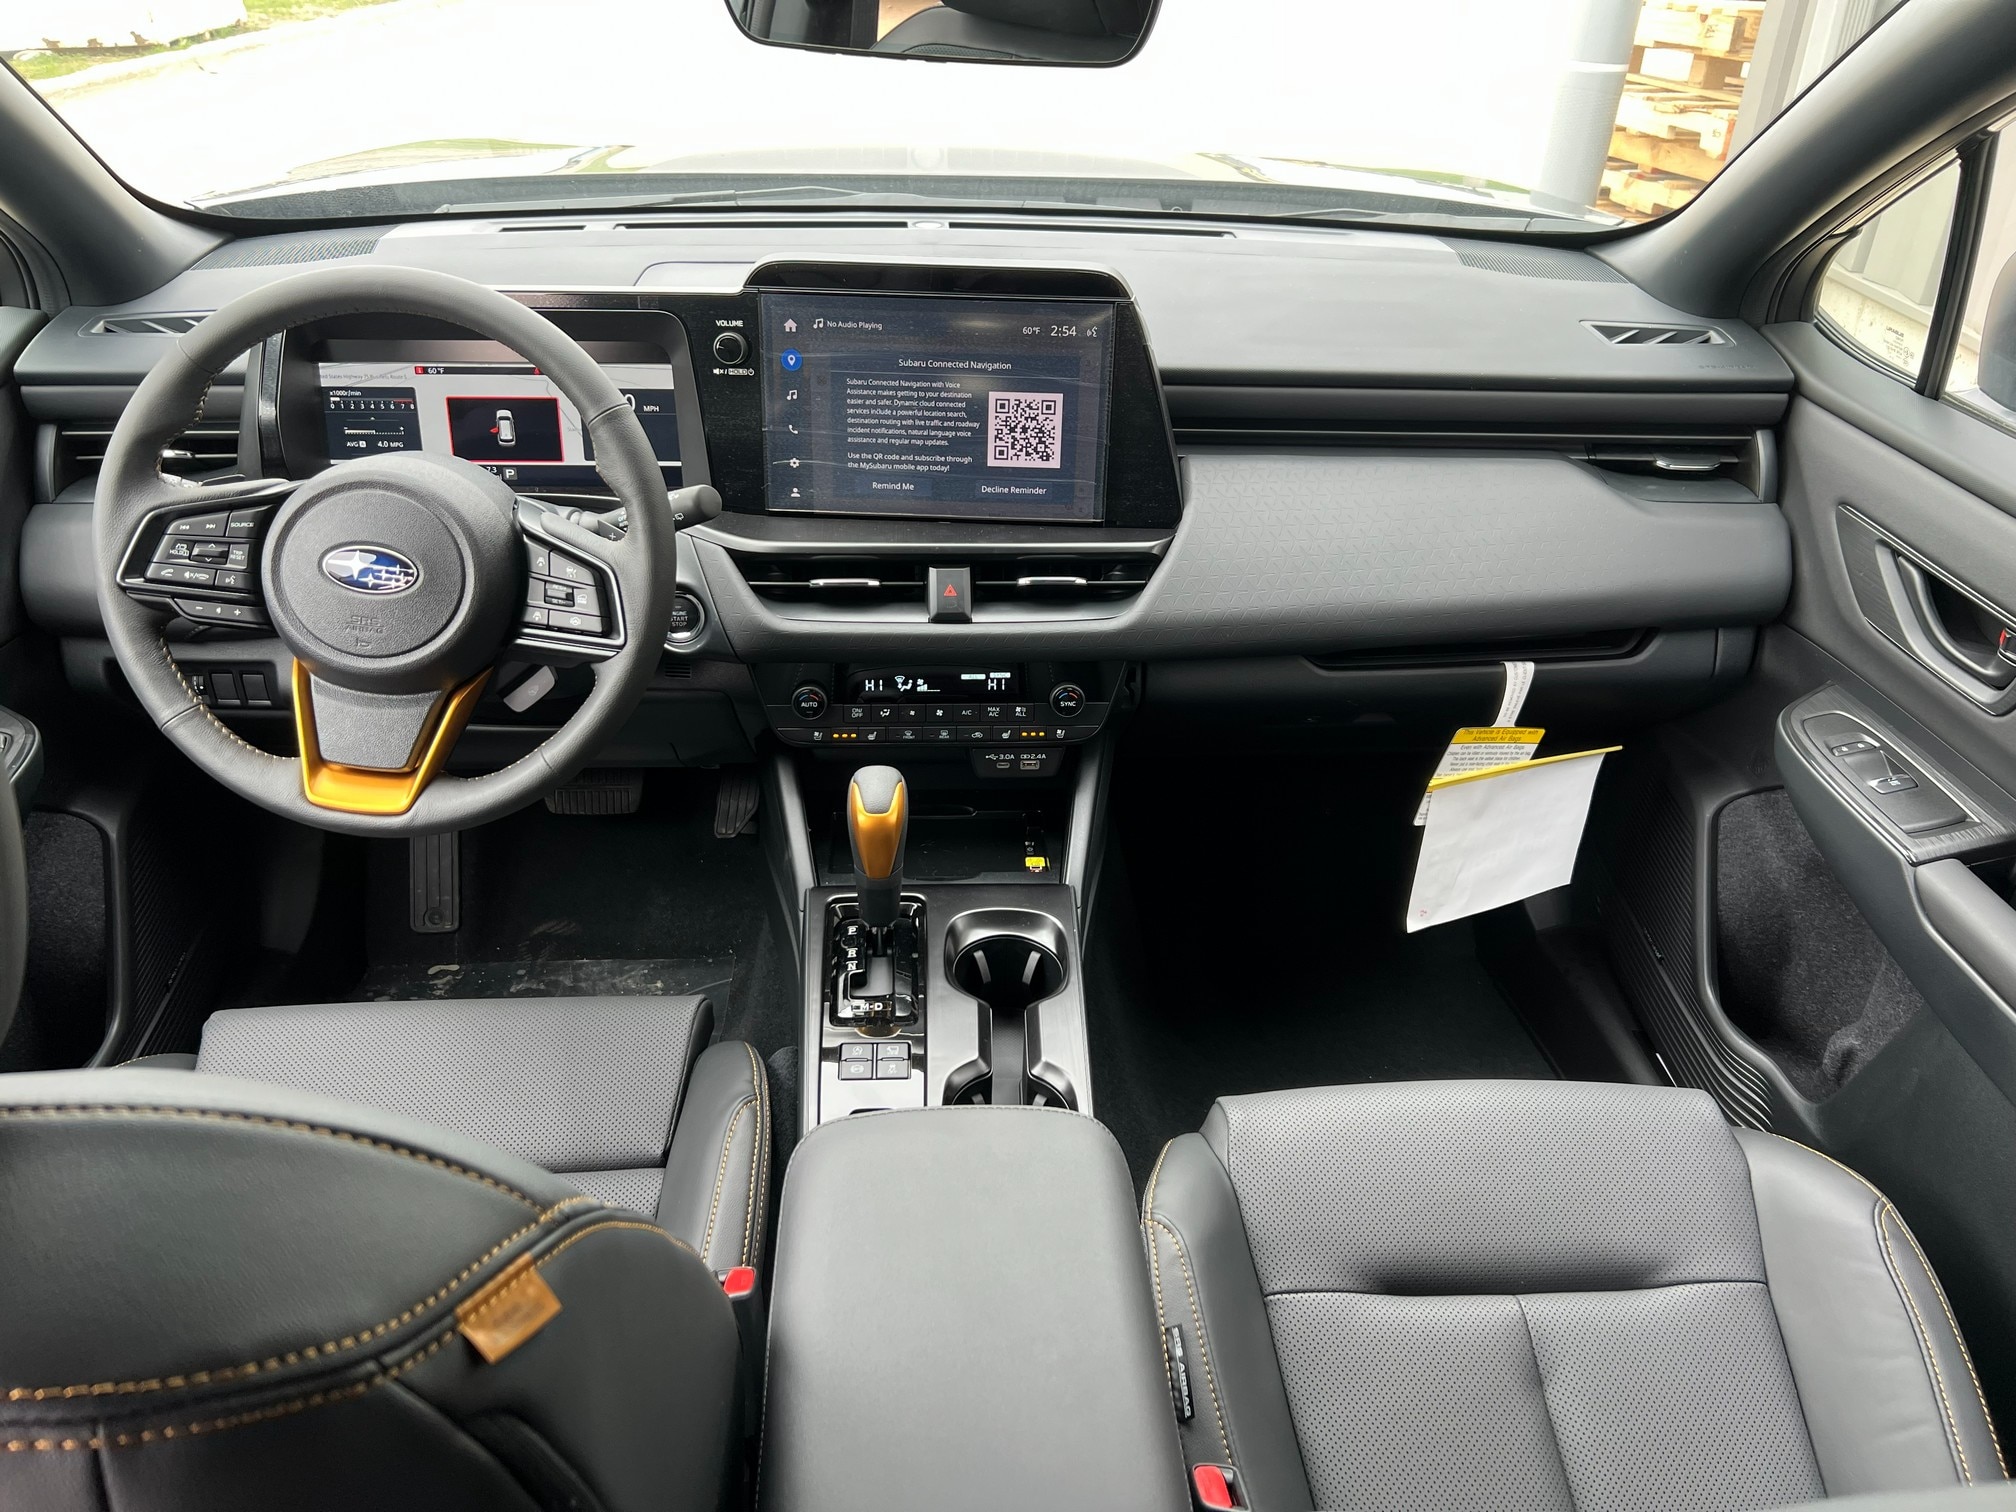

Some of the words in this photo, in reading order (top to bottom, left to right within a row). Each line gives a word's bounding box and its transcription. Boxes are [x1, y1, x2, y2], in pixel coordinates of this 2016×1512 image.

[859, 322, 882, 330] Playing
[1051, 326, 1076, 336] 2:54
[899, 359, 926, 367] Subaru
[928, 360, 968, 368] Connected
[971, 361, 1011, 371] Navigation
[900, 380, 930, 388] Navigation
[897, 390, 917, 398] getting
[956, 421, 980, 429] roadway
[946, 456, 972, 464] through
[860, 462, 892, 470] MySubaru
[505, 469, 514, 478] P
[873, 482, 900, 490] Remind
[1179, 1362, 1191, 1418] AIRBAG
